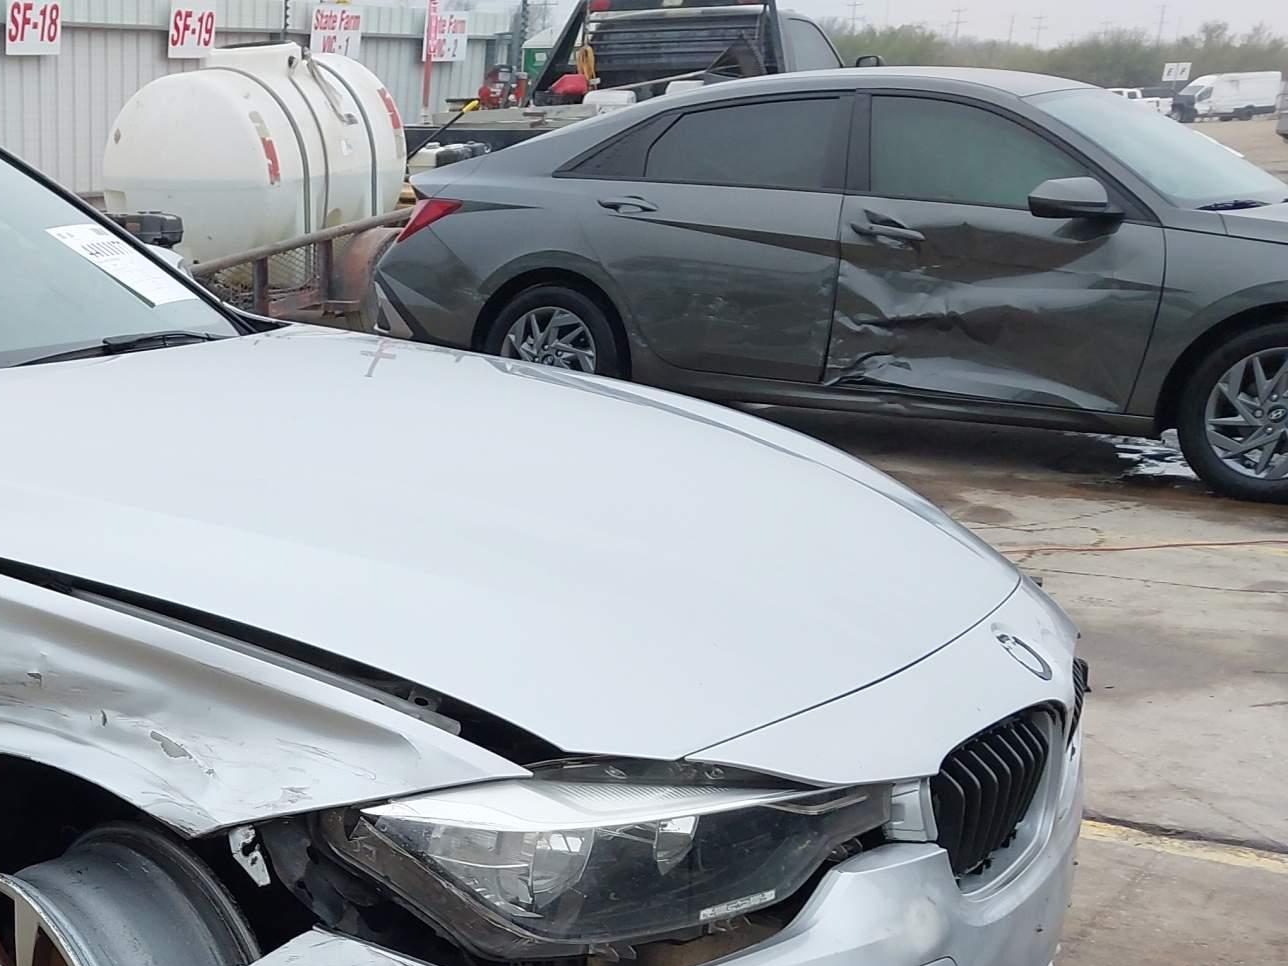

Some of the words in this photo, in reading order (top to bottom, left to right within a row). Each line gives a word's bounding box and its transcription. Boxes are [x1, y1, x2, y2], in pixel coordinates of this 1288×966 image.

[8, 3, 59, 42] SF-18
[171, 9, 214, 46] SF-19
[314, 9, 337, 30] State
[339, 9, 361, 31] Farm
